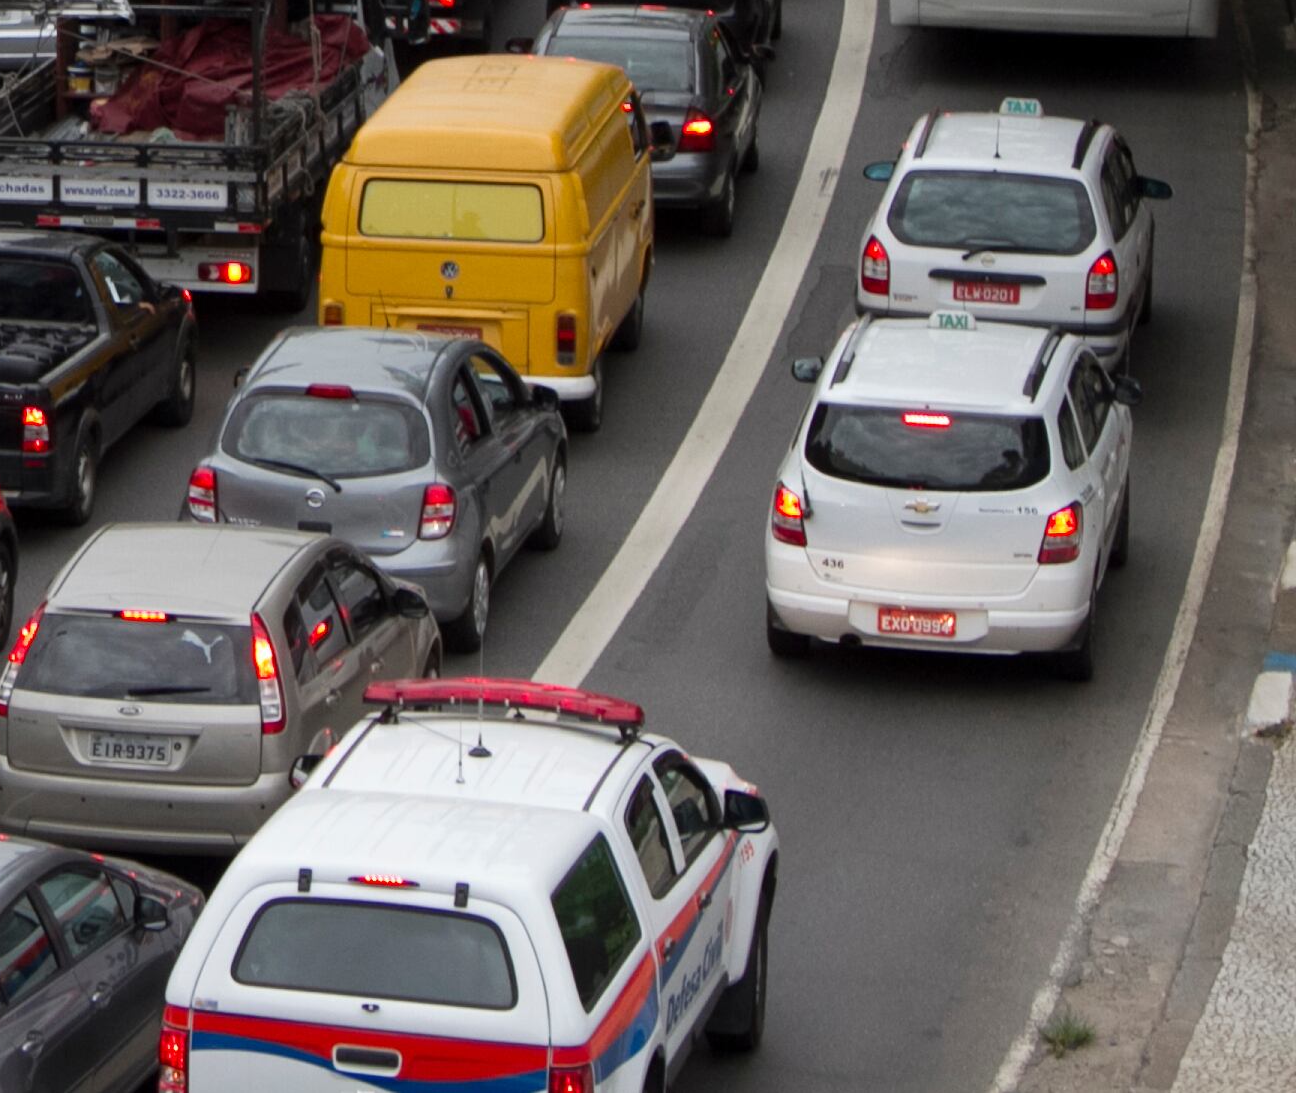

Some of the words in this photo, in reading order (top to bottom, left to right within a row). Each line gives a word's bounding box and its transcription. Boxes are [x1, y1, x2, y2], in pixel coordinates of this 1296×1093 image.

[1007, 100, 1037, 115] TAXI
[156, 189, 220, 201] 3322-3666
[937, 313, 968, 328] TAXI
[822, 558, 844, 570] 436
[665, 965, 701, 1035] Defesa
